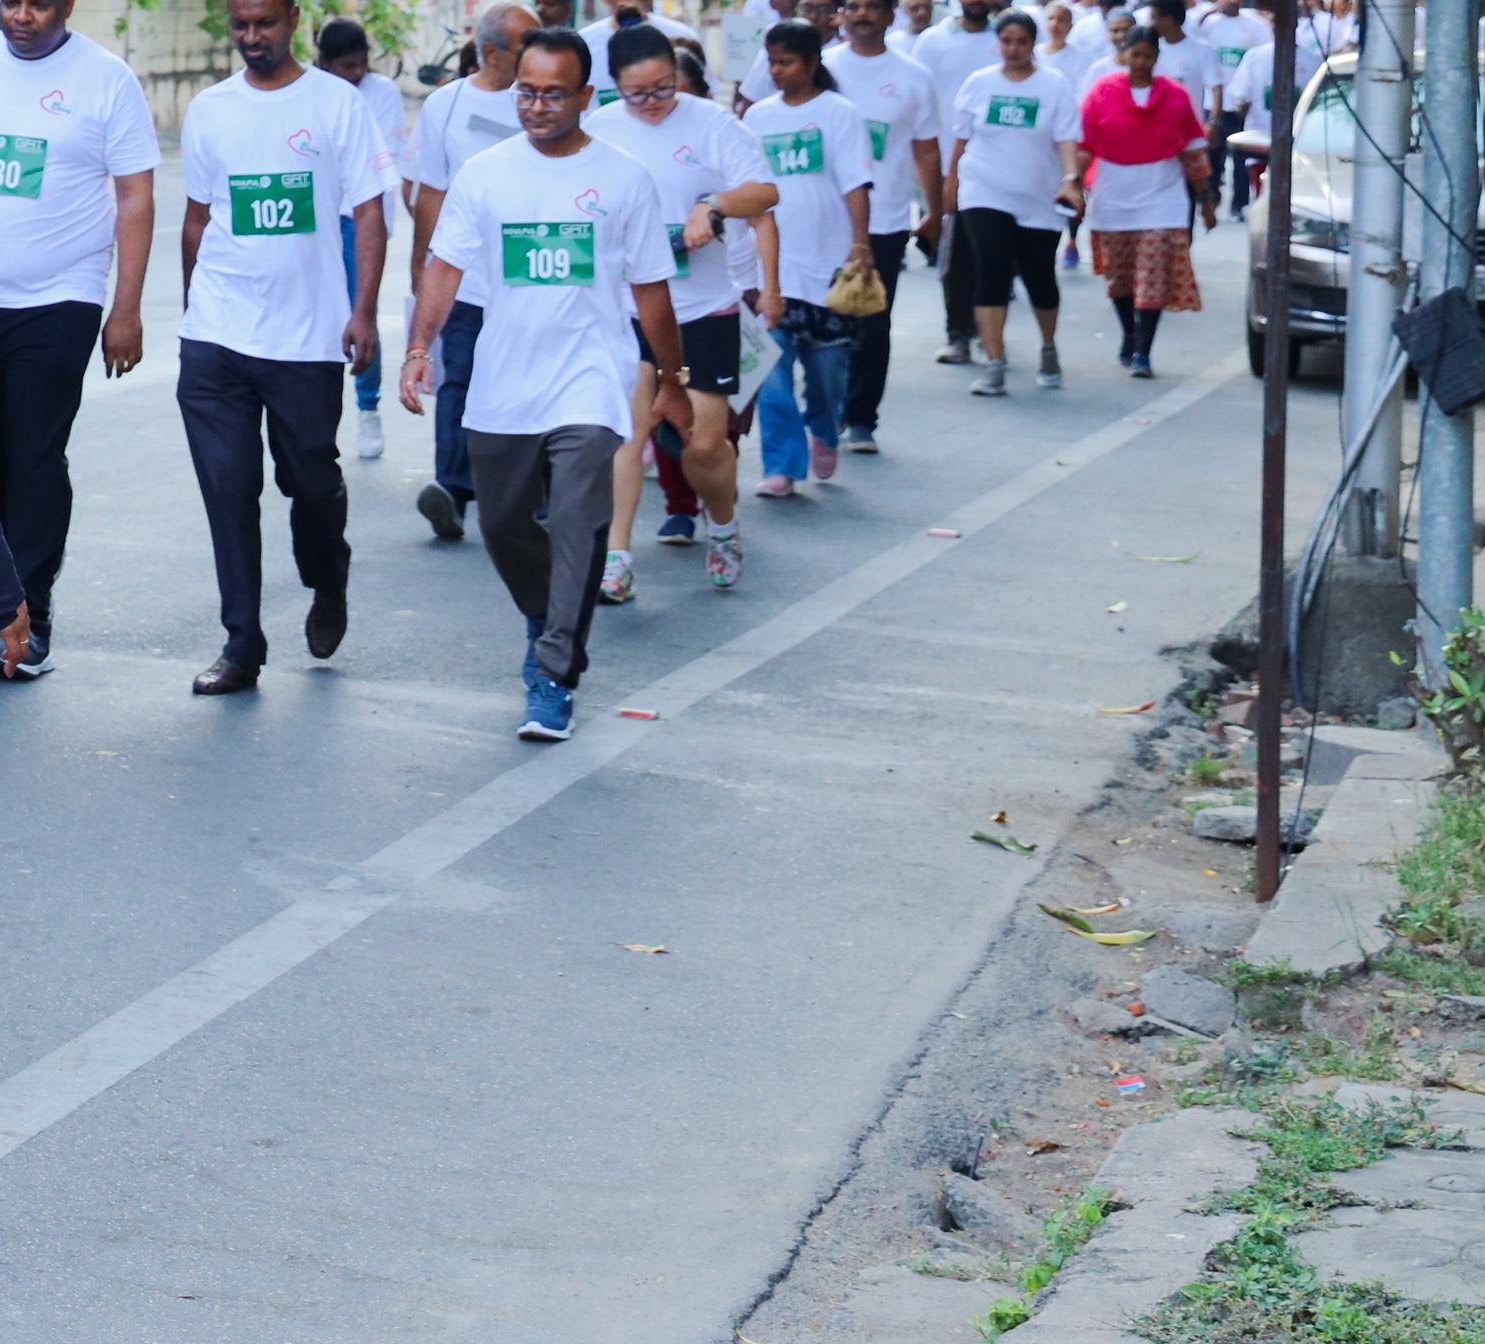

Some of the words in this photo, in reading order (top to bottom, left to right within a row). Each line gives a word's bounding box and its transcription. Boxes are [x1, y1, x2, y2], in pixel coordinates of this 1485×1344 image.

[777, 147, 810, 171] 144
[250, 198, 294, 229] 102
[526, 248, 570, 279] 109
